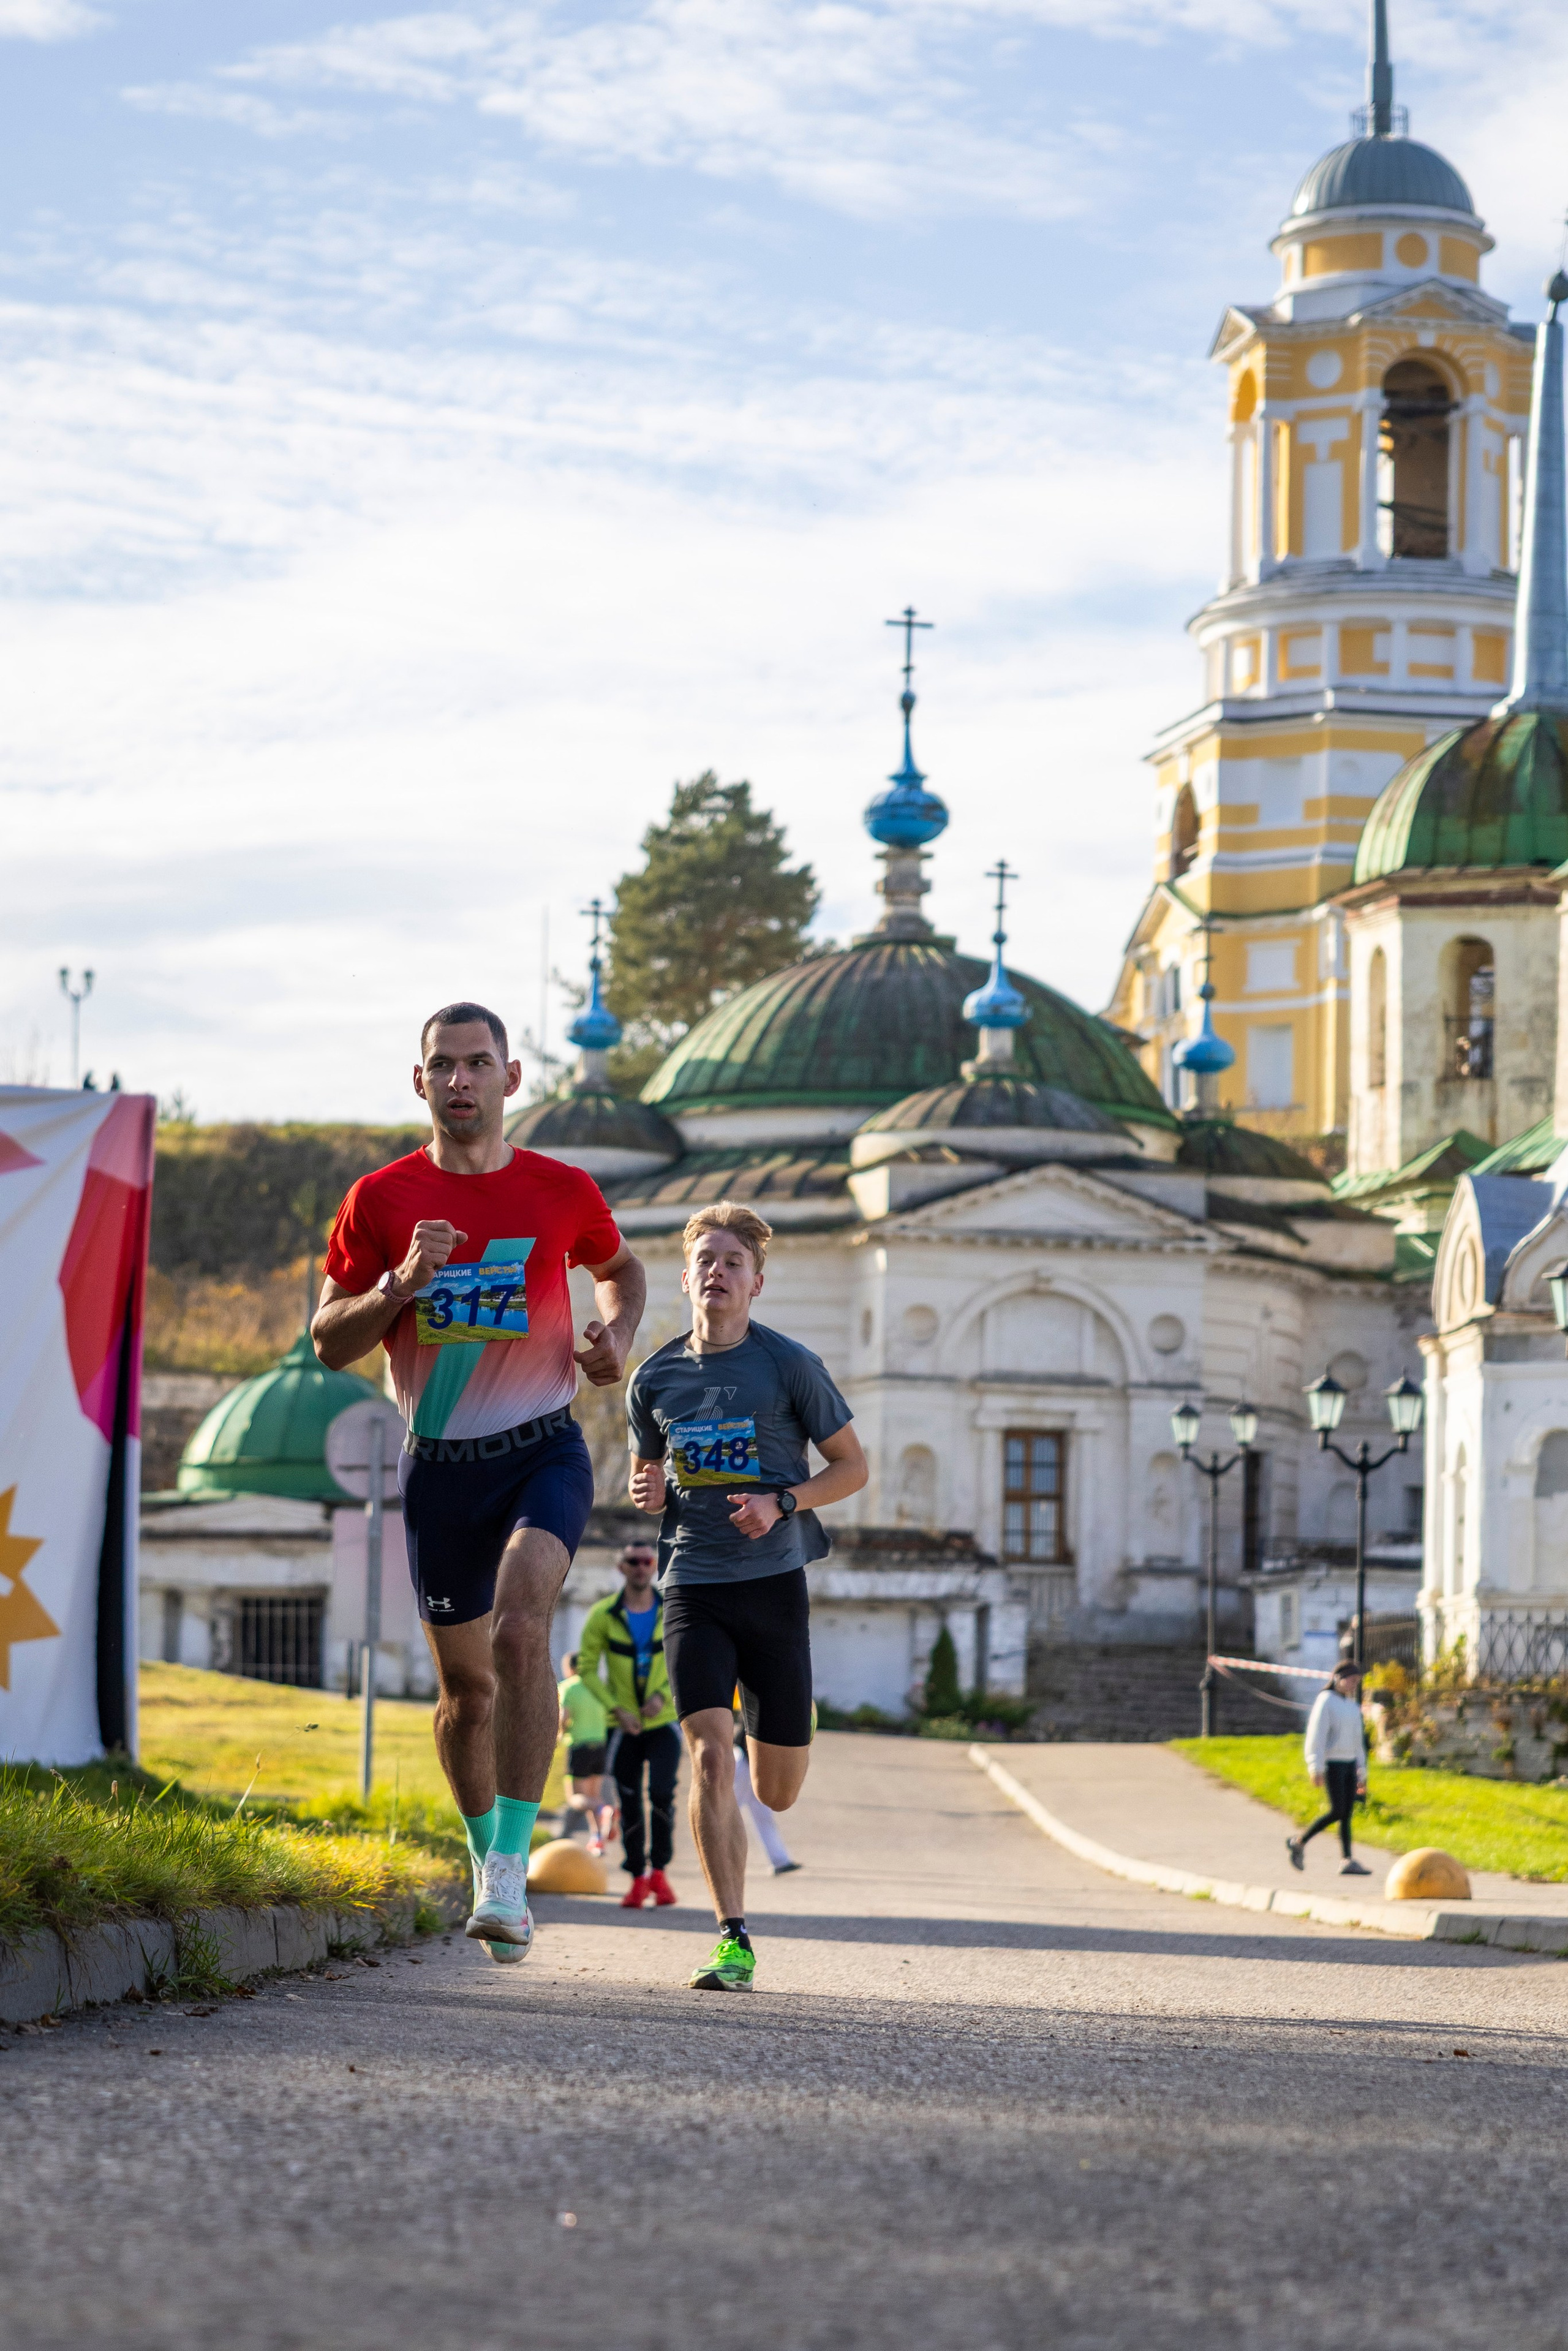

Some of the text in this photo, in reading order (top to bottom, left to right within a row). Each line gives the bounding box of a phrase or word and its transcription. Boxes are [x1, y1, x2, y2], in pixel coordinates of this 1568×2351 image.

[433, 1266, 517, 1278] АРИЦКИЕ ВЕРСТЫ
[427, 1284, 518, 1330] 317
[404, 1408, 570, 1463] RMOUR
[675, 1425, 713, 1433] СТАРИЦКИЕ
[683, 1436, 749, 1475] 348
